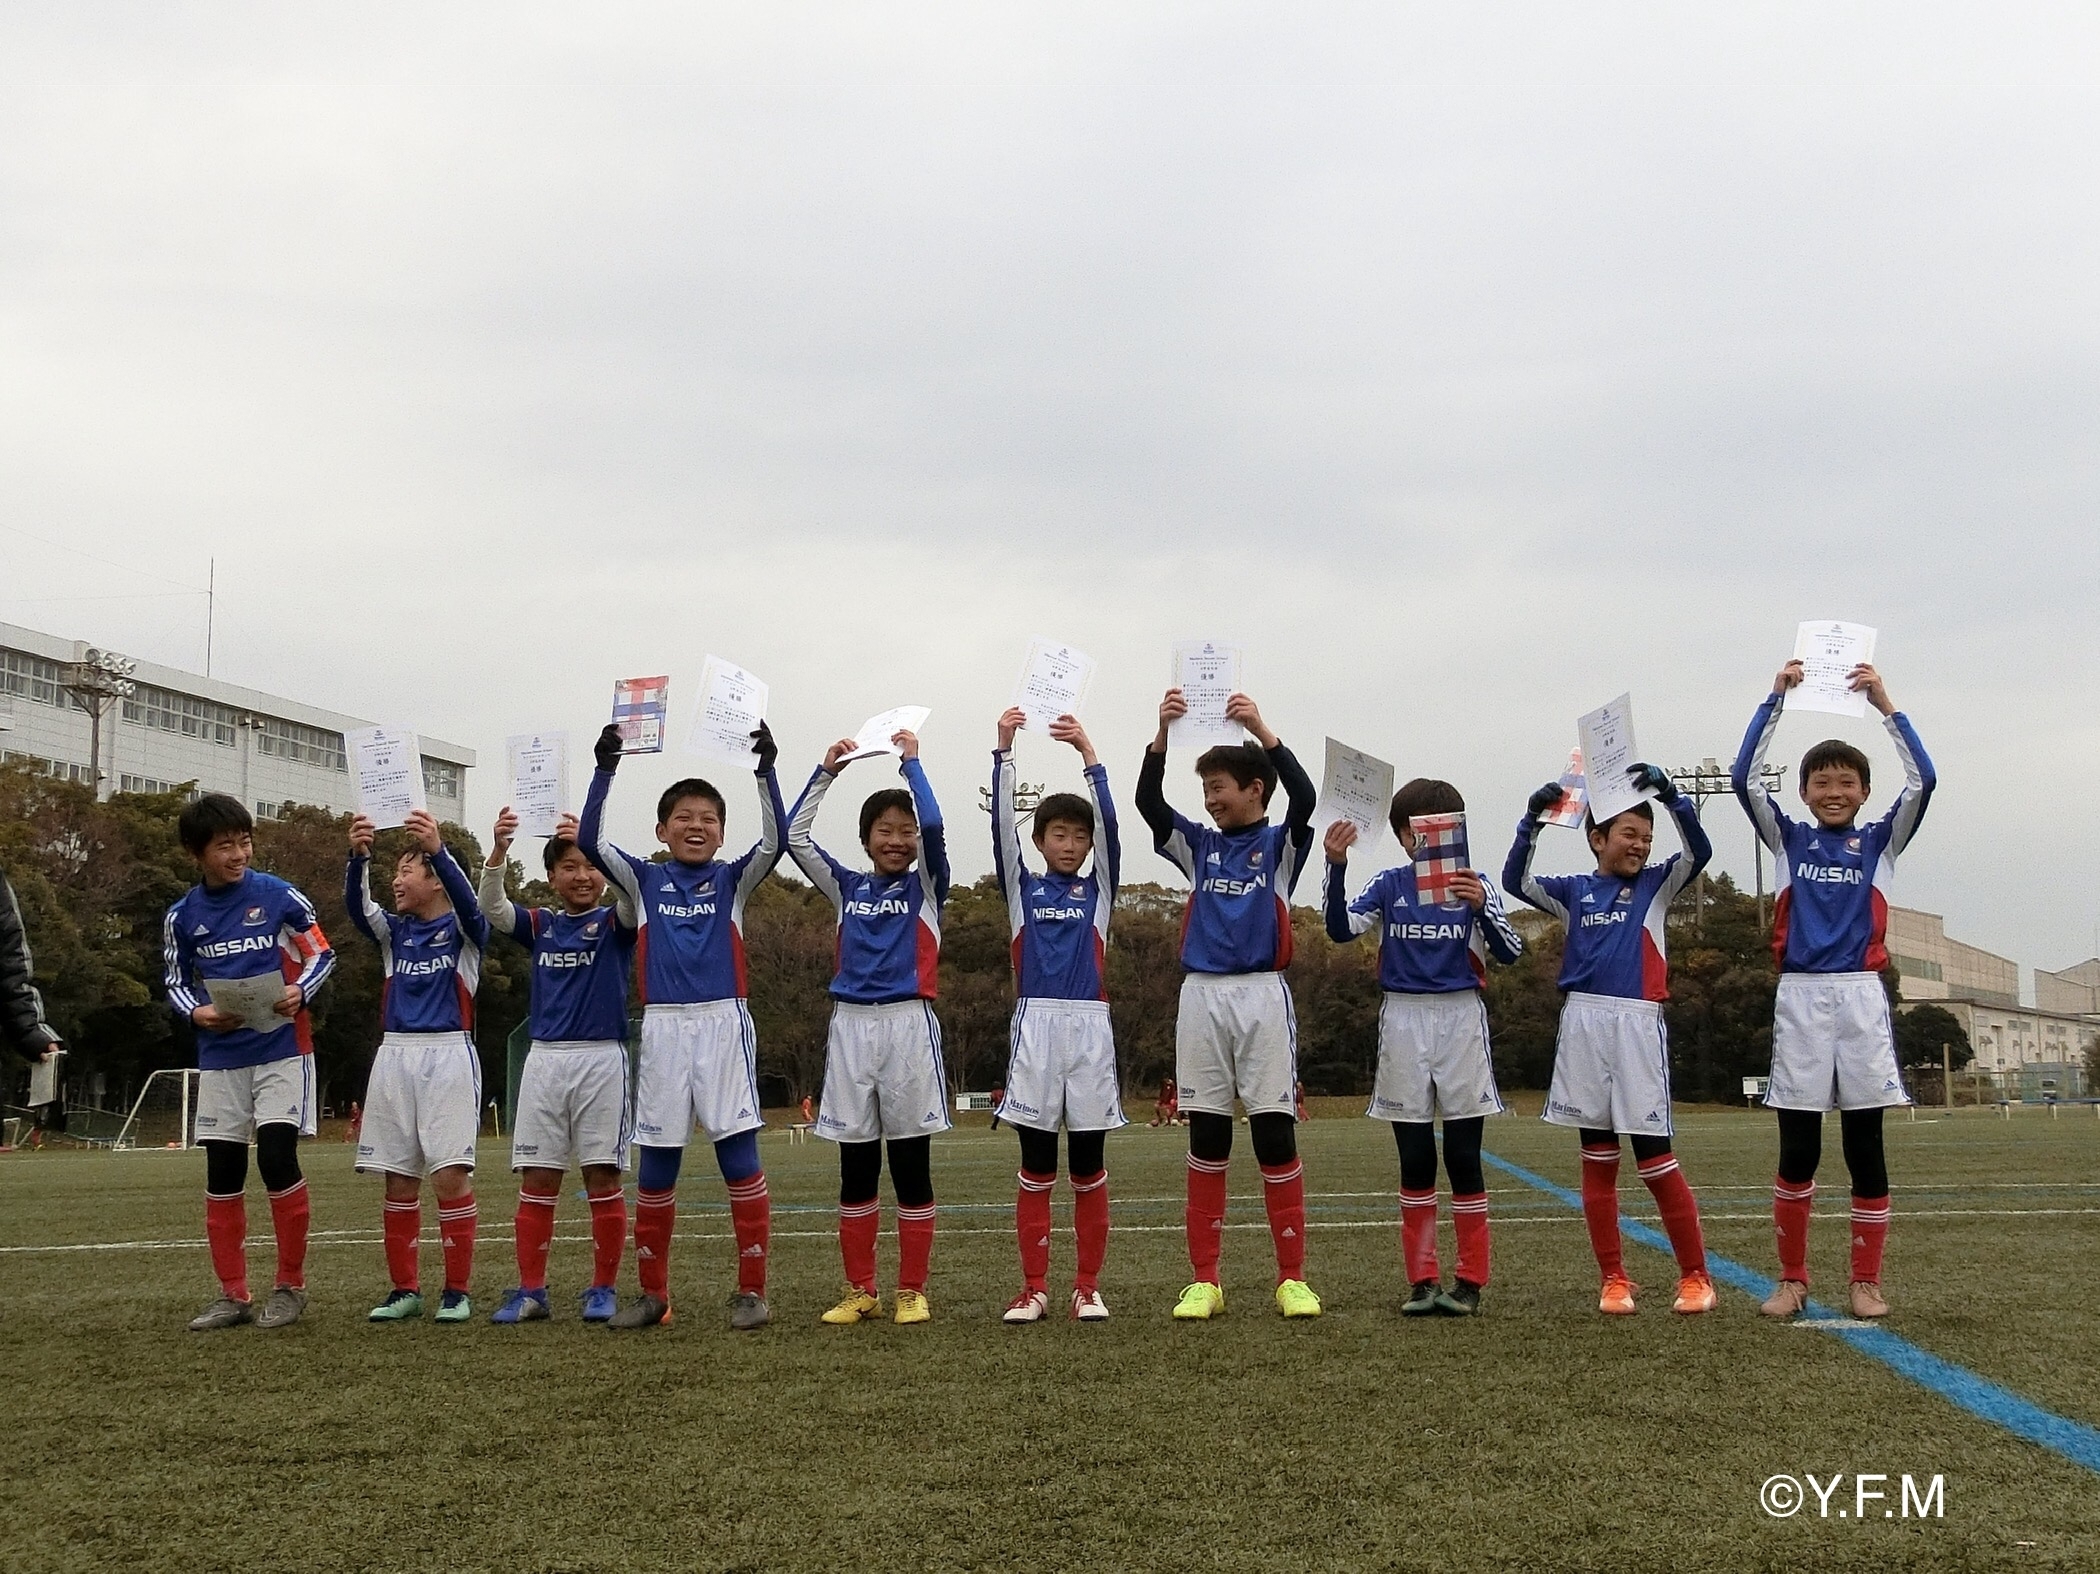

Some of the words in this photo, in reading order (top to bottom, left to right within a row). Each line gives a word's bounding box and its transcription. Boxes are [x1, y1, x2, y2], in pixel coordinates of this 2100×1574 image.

[1202, 872, 1267, 896] NISSAN
[658, 902, 716, 918] NISSAN
[1032, 907, 1086, 920] NISSAN
[1389, 923, 1466, 940] NISSAN
[196, 934, 274, 959] NISSAN
[1009, 1097, 1040, 1115] Marinos
